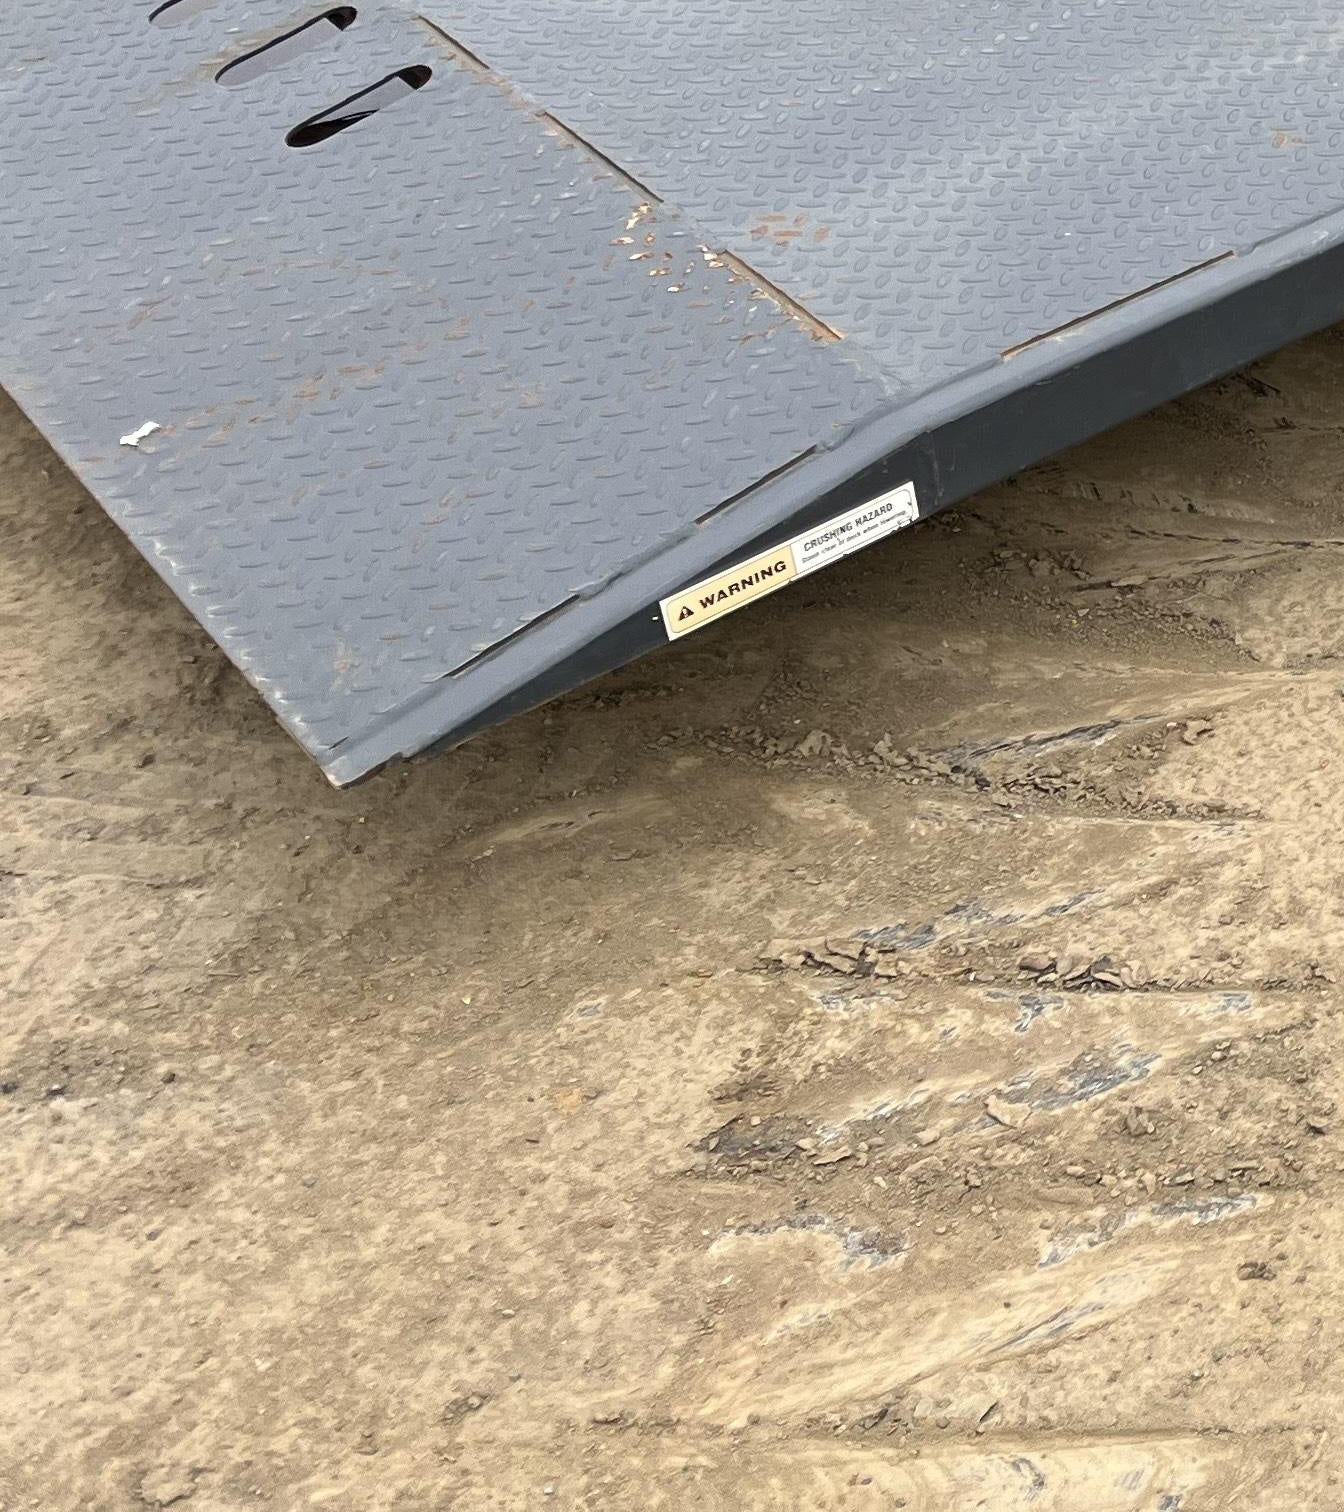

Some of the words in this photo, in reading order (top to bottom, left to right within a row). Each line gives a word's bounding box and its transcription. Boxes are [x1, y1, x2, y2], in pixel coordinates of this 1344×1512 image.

[803, 521, 853, 552] CRUSHING
[855, 502, 893, 526] HAZARD
[699, 560, 787, 609] WARNING
